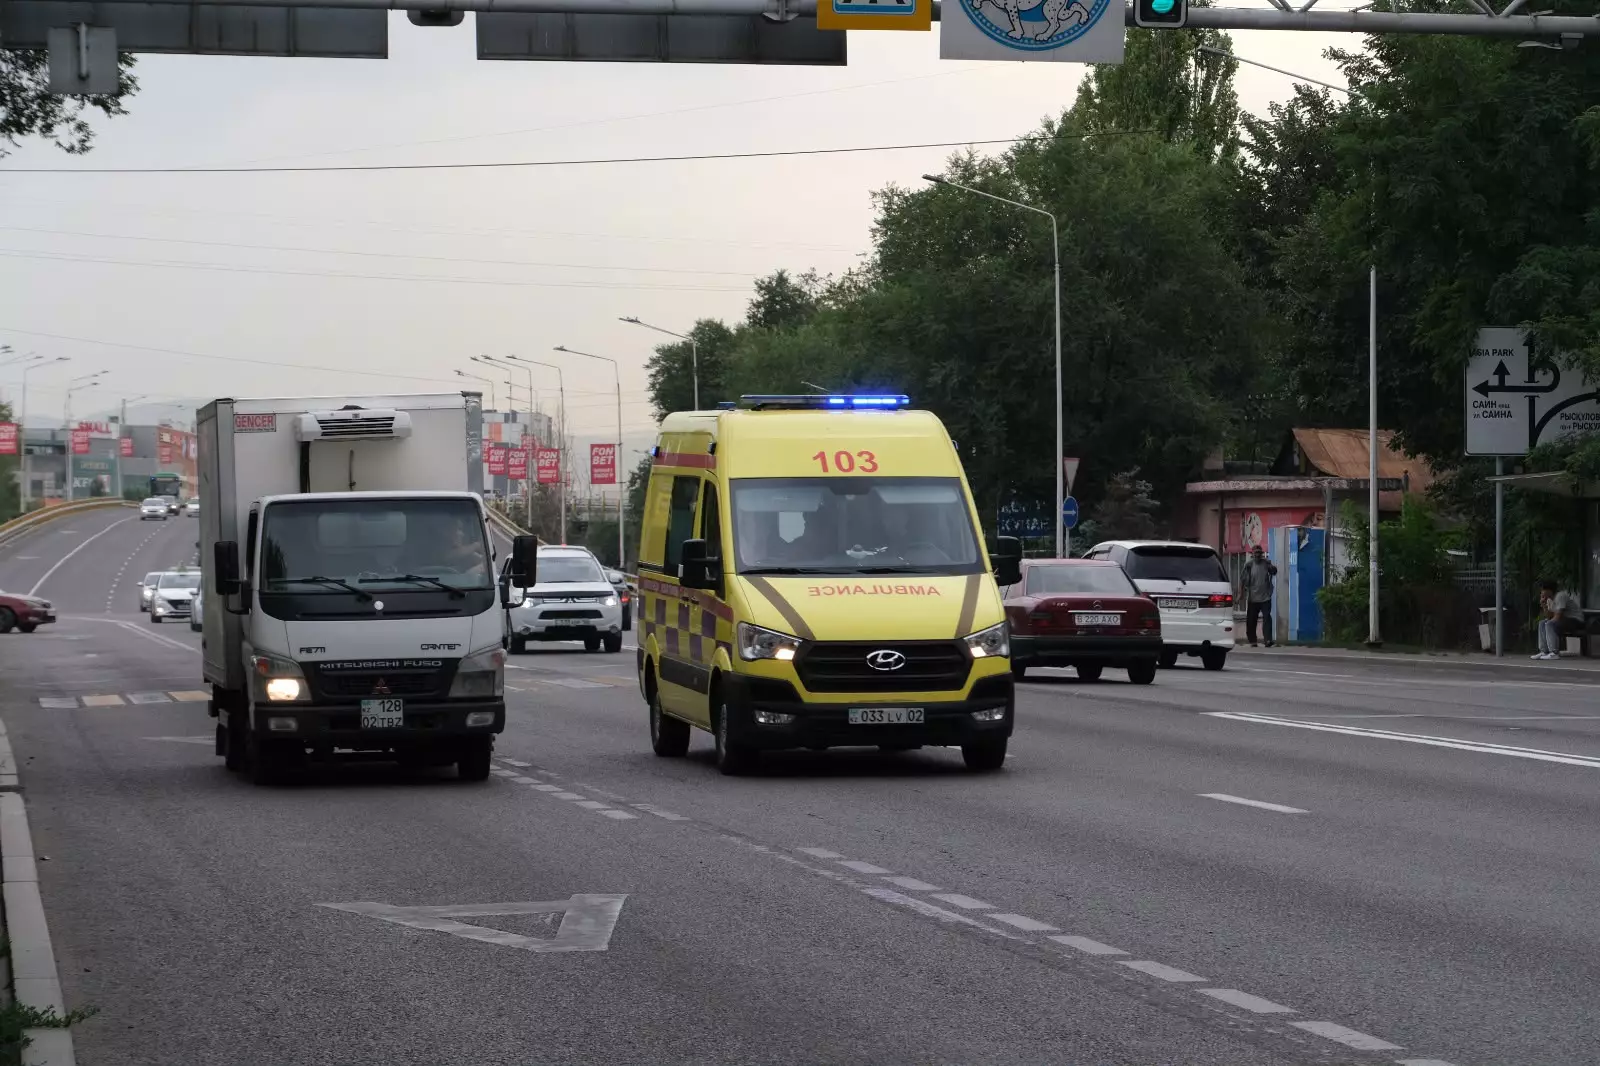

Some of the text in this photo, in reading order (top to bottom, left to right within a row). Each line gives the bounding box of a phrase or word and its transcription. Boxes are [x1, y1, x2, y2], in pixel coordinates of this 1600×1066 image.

[1492, 348, 1514, 356] PARK
[1472, 400, 1497, 409] САИН
[1482, 410, 1513, 418] САИНА
[236, 415, 274, 427] GENCER
[592, 447, 614, 455] FON
[538, 459, 558, 467] BET
[592, 456, 614, 465] BET
[812, 450, 879, 473] 103
[1085, 615, 1099, 623] 220
[320, 661, 399, 669] MITSUBISHI
[378, 700, 402, 713] 128
[861, 710, 923, 722] 033 LV 02
[363, 716, 402, 728] 02 TBZ
